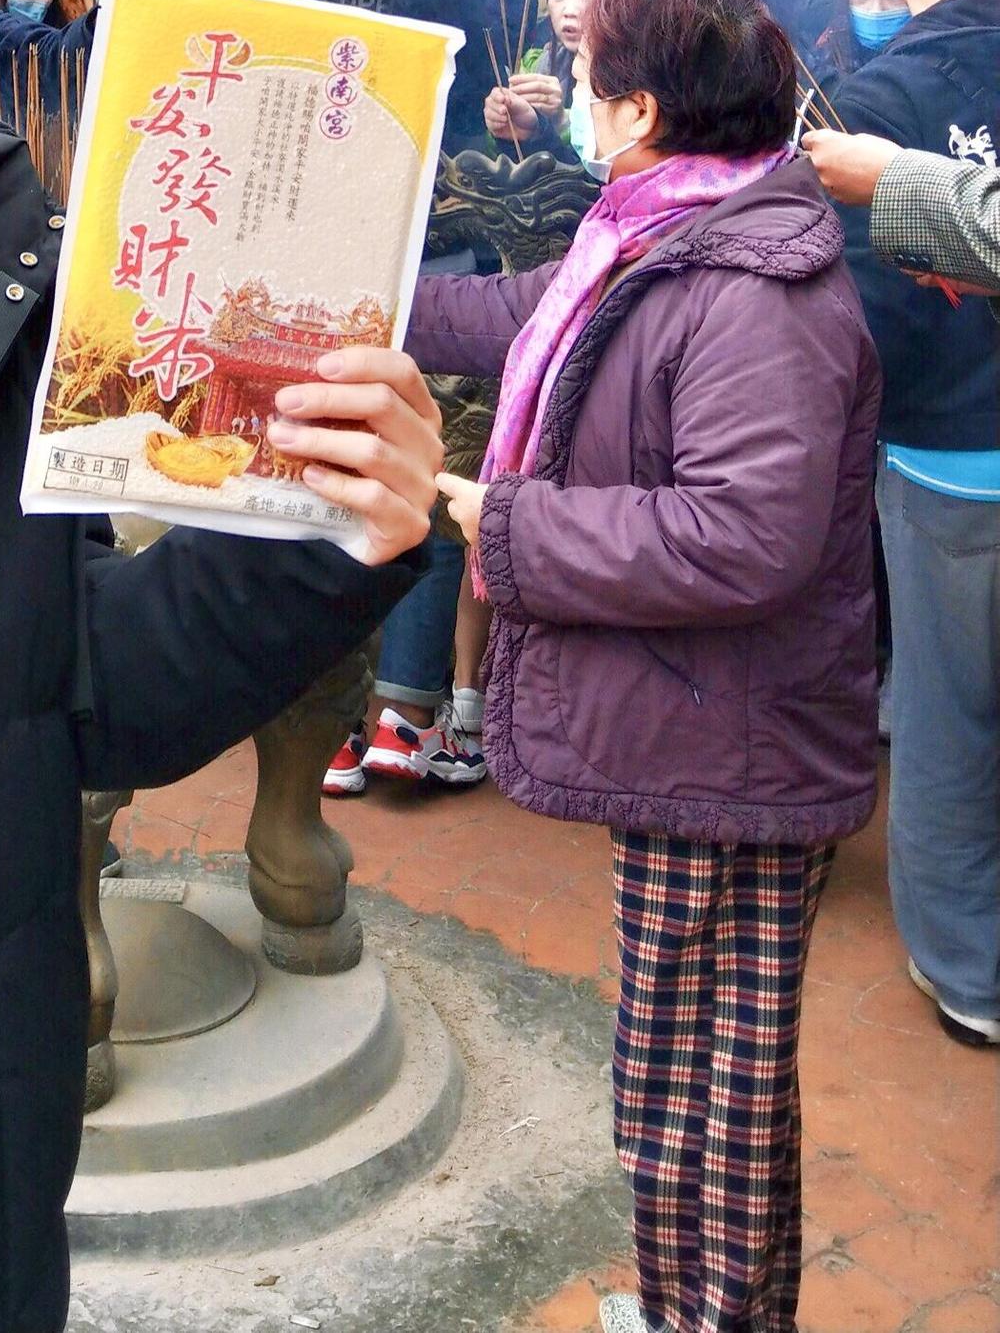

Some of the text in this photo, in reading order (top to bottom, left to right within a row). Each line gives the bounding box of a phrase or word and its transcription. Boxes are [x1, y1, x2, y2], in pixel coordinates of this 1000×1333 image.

[324, 41, 361, 137] 紫南宮
[115, 34, 243, 399] 平安發財米
[52, 451, 126, 479] 製造日期
